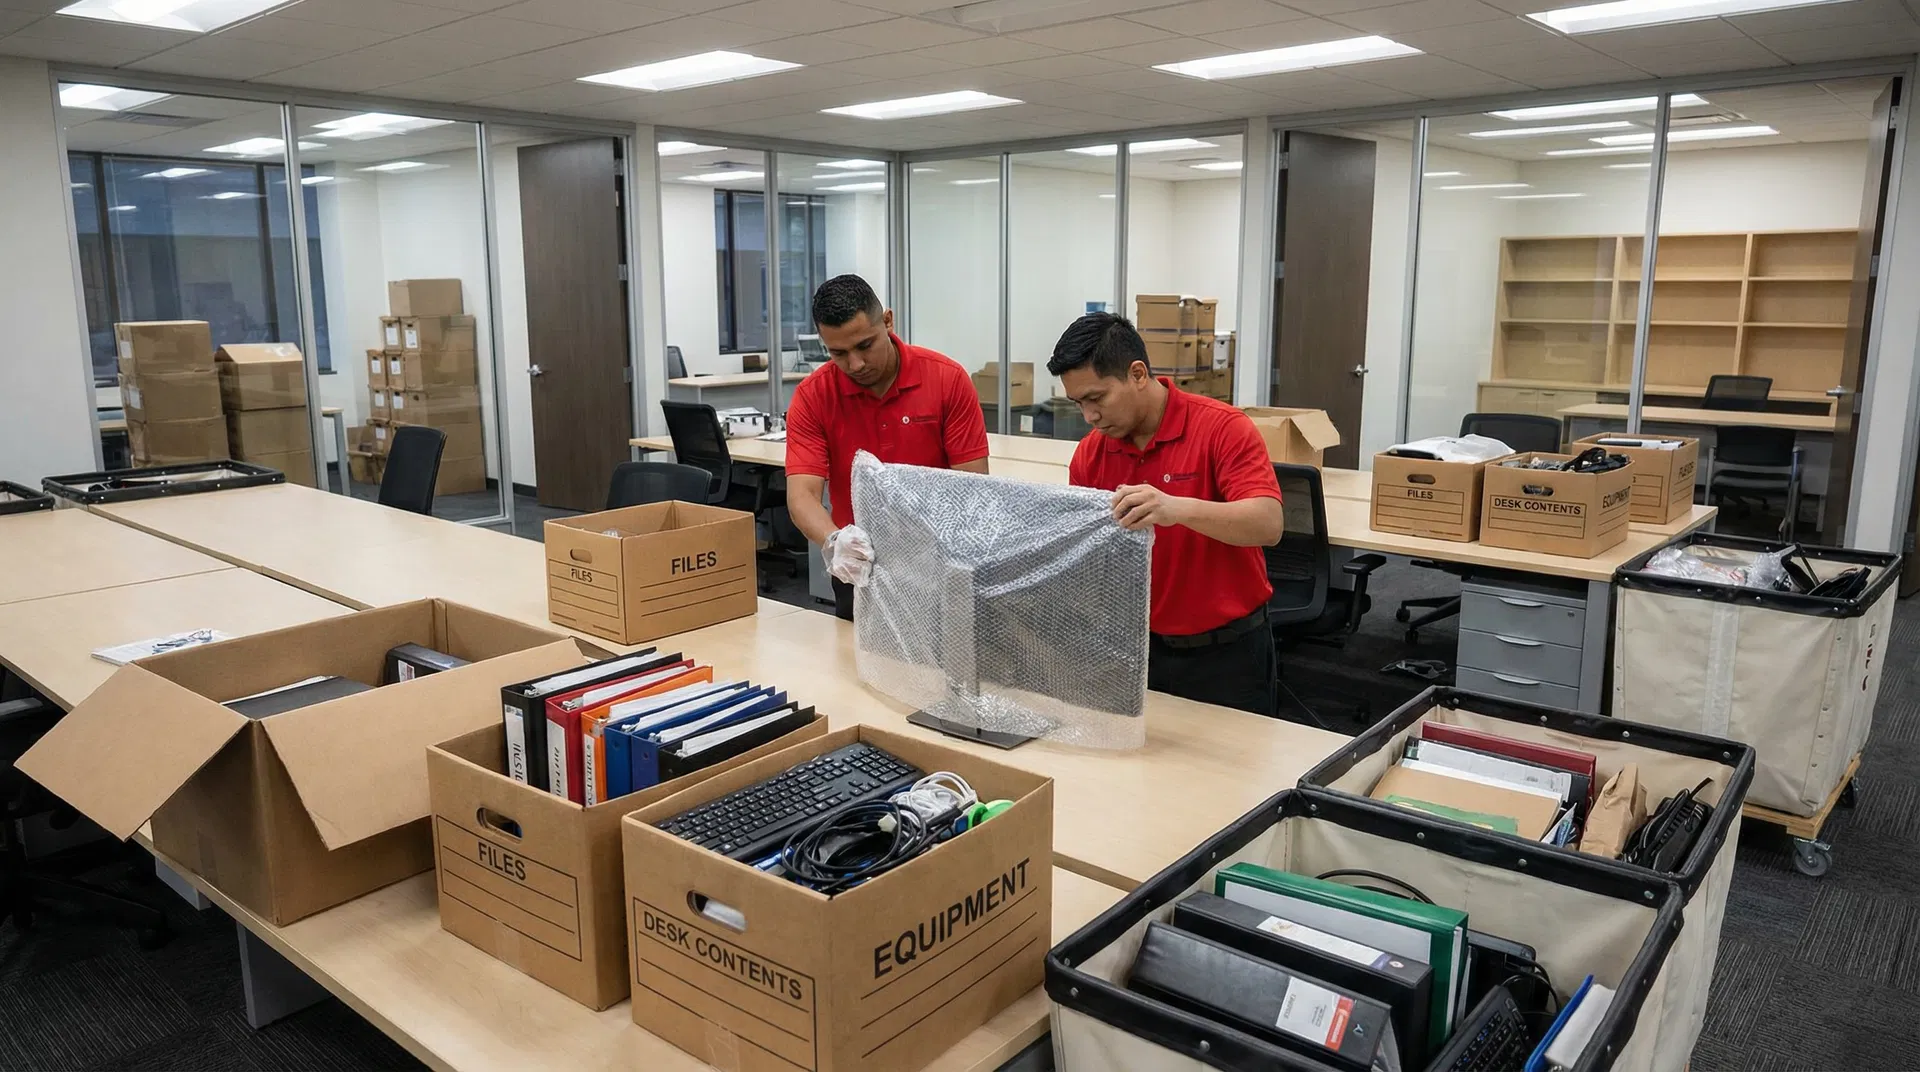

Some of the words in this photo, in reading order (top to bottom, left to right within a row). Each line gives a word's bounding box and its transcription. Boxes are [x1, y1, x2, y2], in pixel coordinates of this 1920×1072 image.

[1407, 489, 1434, 500] FILES
[1494, 498, 1522, 509] DESK
[1524, 501, 1582, 515] CONTENTS
[671, 551, 717, 575] FILES
[571, 568, 593, 583] FILES
[478, 841, 527, 881] FILES
[874, 857, 1030, 980] EQUIPMENT
[643, 911, 691, 950] DESK
[695, 937, 803, 1001] CONTENTS
